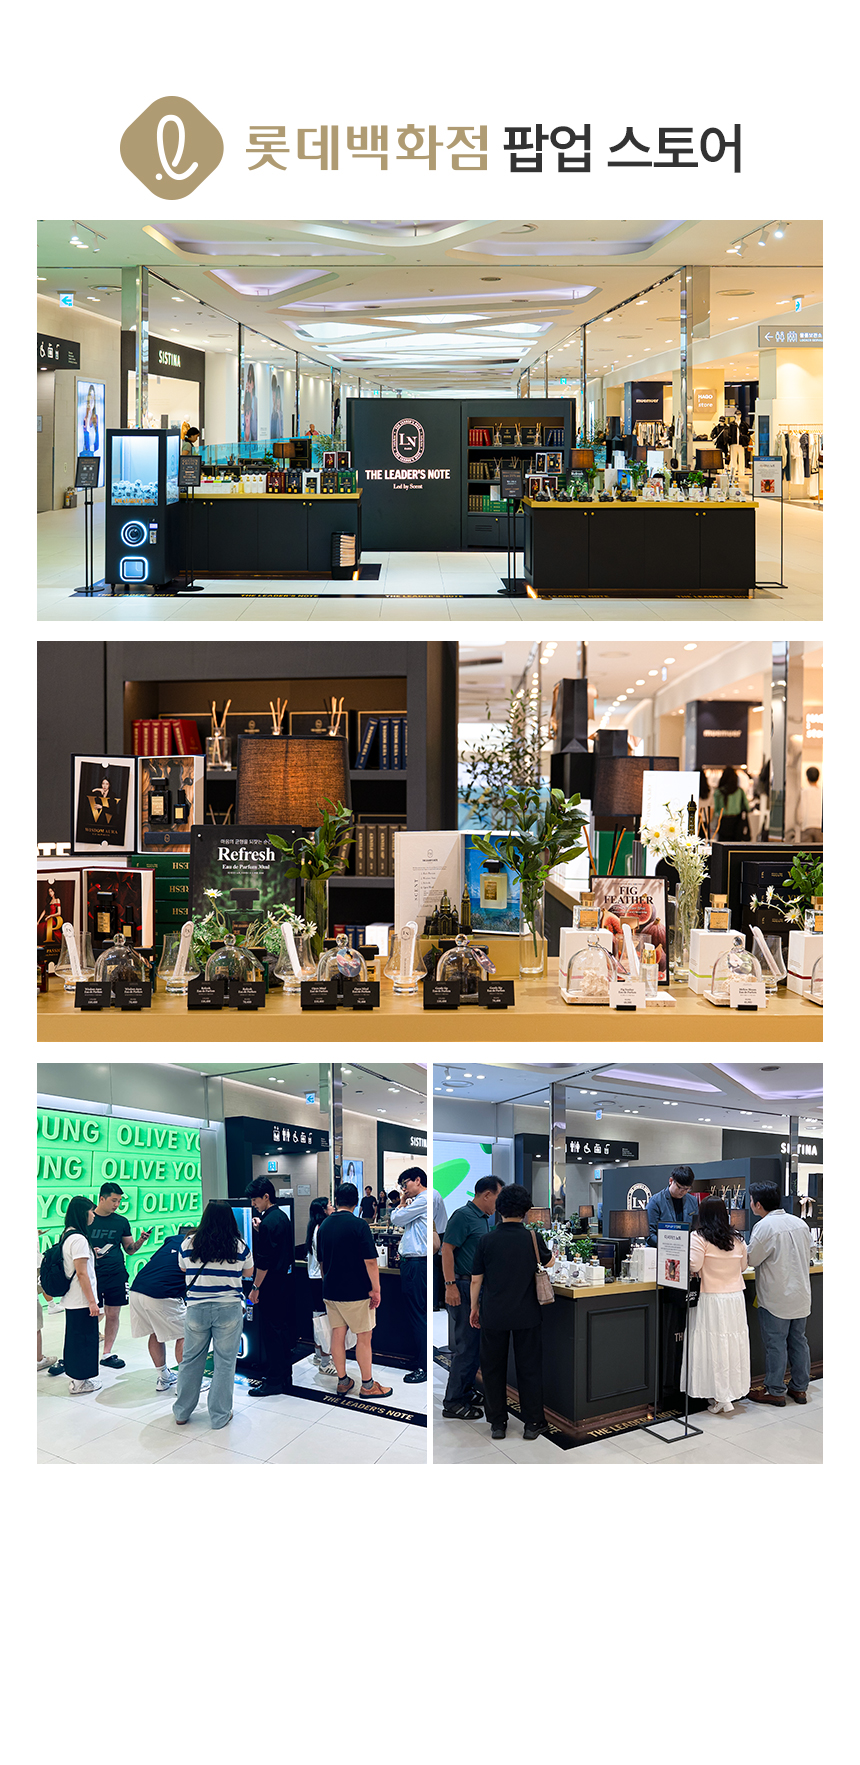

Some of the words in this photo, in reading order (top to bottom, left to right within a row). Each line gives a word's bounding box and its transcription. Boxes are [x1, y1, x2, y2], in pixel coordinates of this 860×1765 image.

[158, 350, 181, 368] SISTINA
[364, 469, 383, 480] THE
[384, 469, 426, 480] LEADER'S
[428, 469, 450, 480] NOTE
[217, 846, 276, 862] Refresh
[620, 886, 638, 895] FIG
[604, 896, 654, 904] FEATHER
[37, 1114, 100, 1144] UNG
[116, 1124, 178, 1150] OLIVE
[780, 1142, 818, 1156] SITINA
[101, 1158, 166, 1180] OLIVE
[143, 1192, 198, 1213] OLIVE
[91, 1229, 116, 1239] UFC
[323, 1394, 342, 1404] THE
[340, 1400, 386, 1414] LEADER'S
[386, 1410, 414, 1420] NOTE
[586, 1427, 612, 1438] THE
